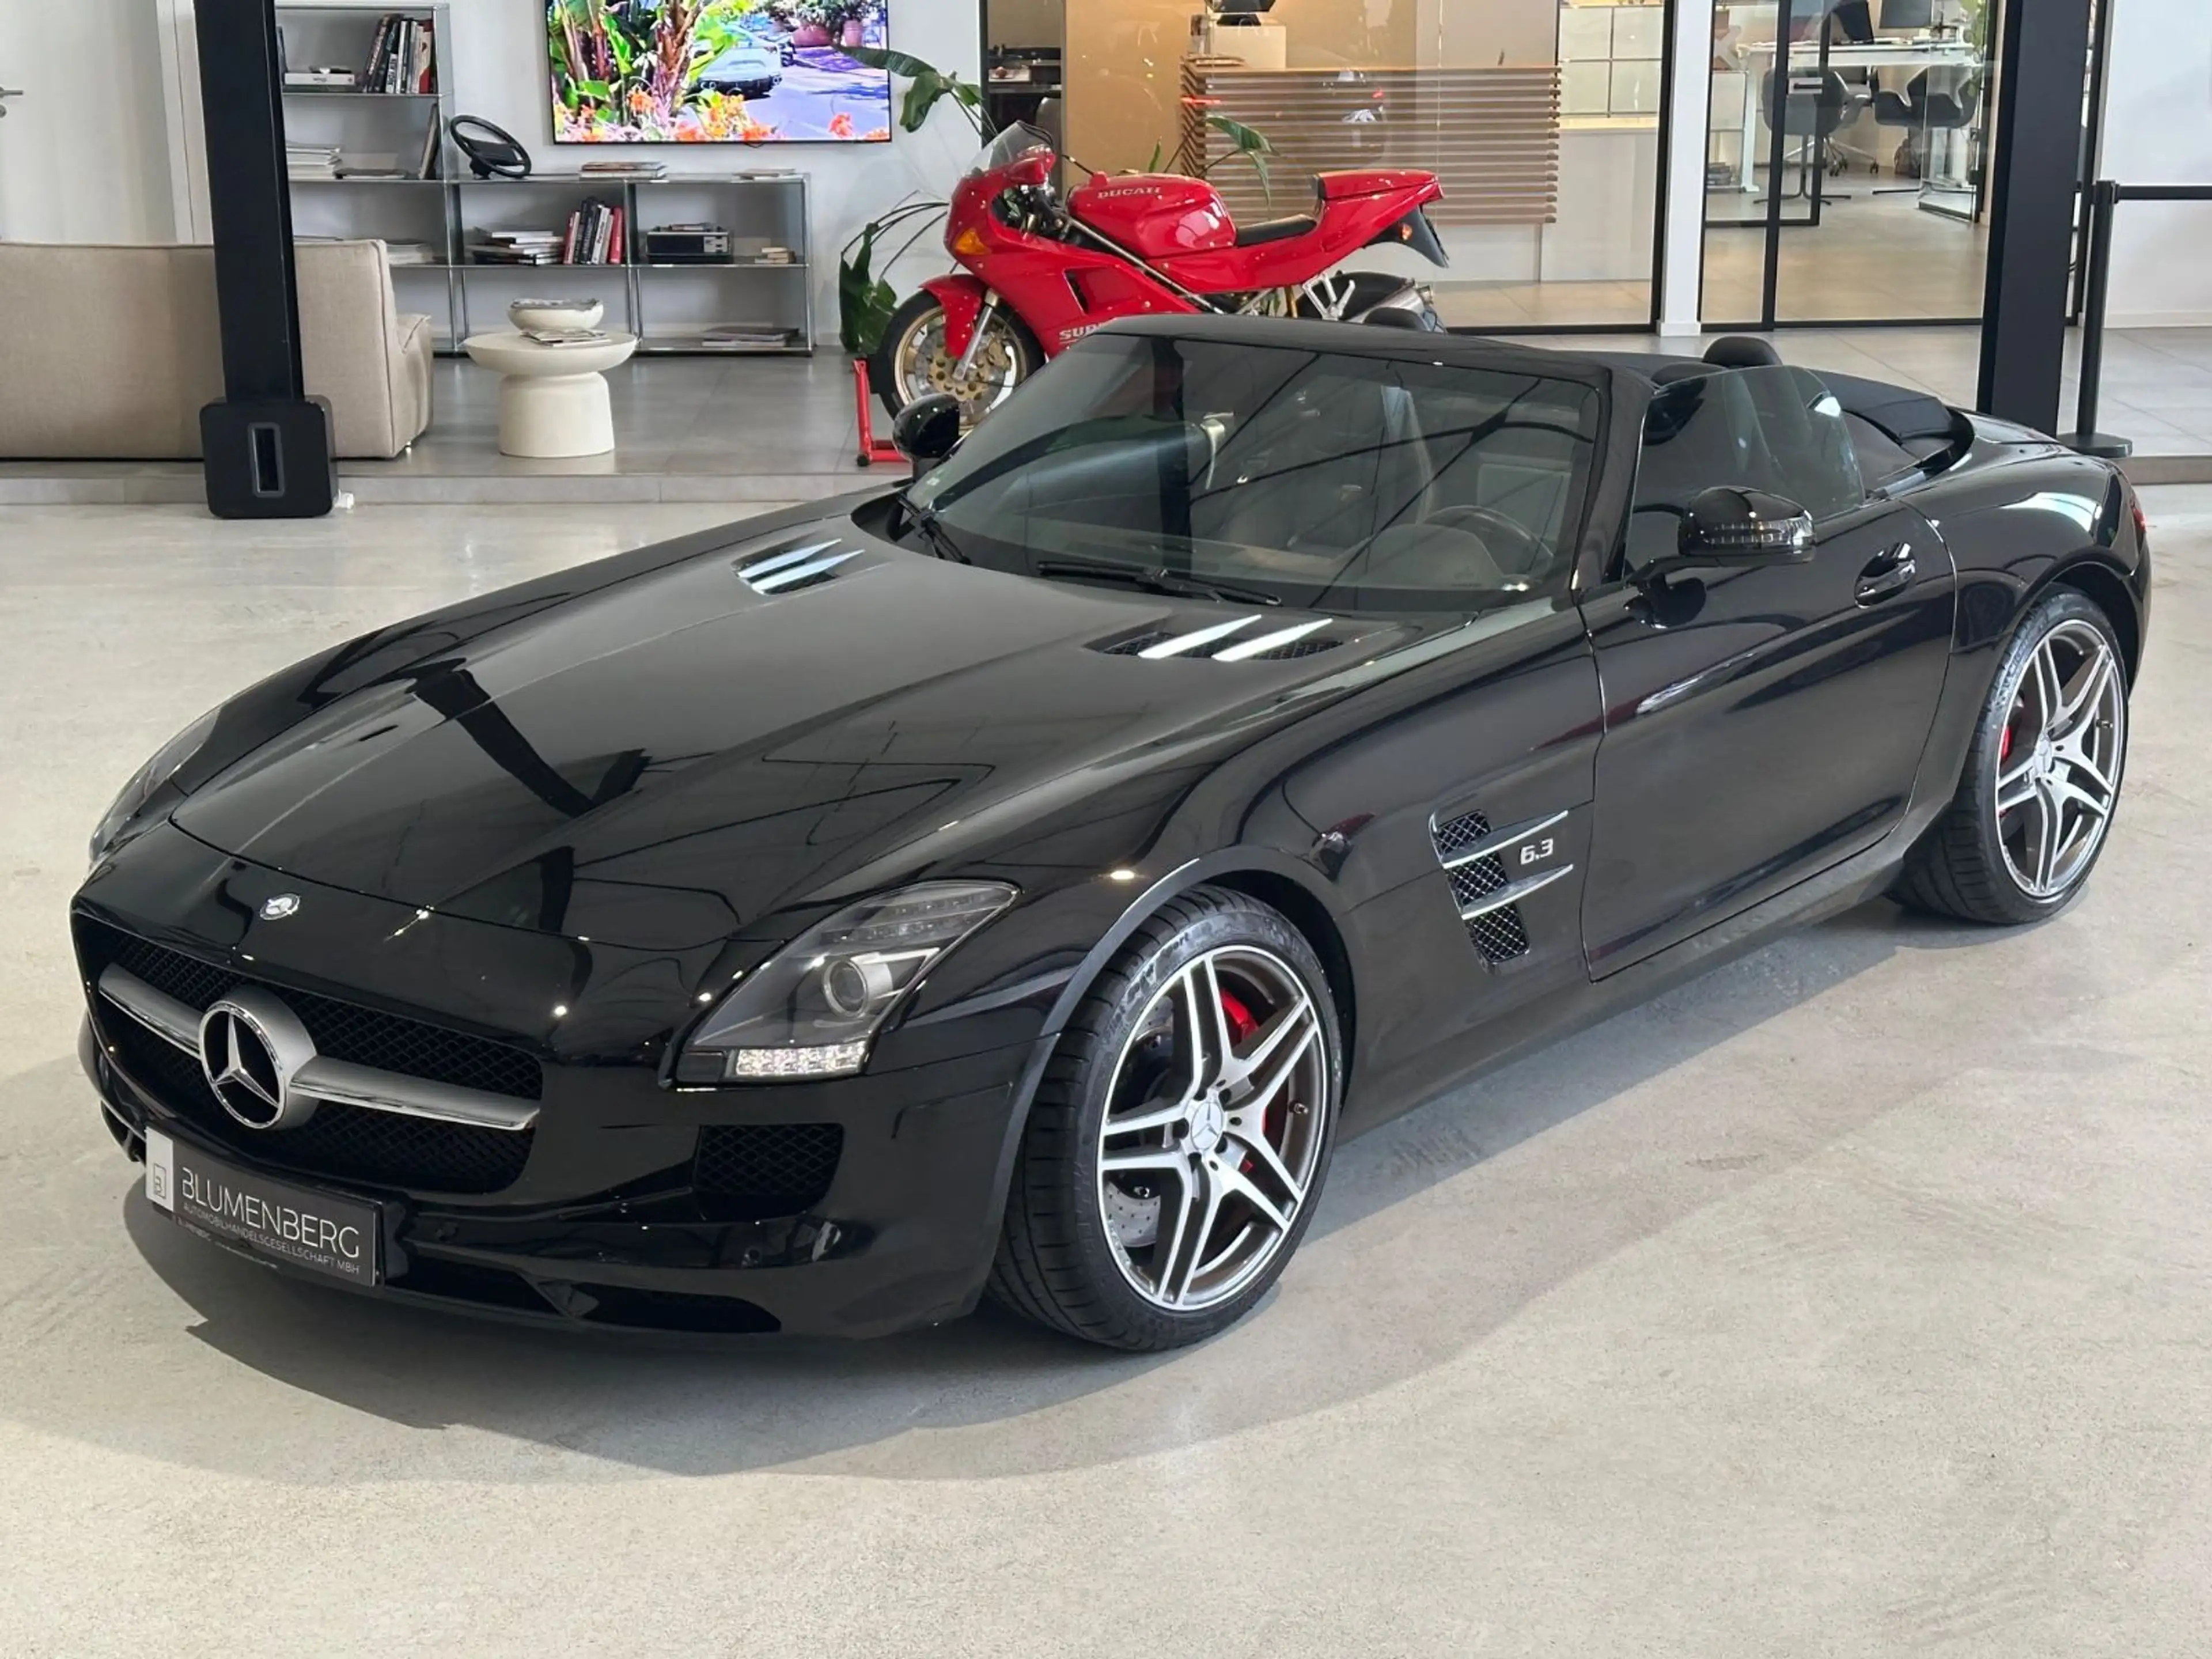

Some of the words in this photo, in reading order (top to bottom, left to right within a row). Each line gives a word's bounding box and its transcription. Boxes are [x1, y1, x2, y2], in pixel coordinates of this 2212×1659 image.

[1097, 186, 1161, 199] DUCATI
[1520, 838, 1554, 865] 6.3
[182, 1166, 359, 1258] BLUMENBERG
